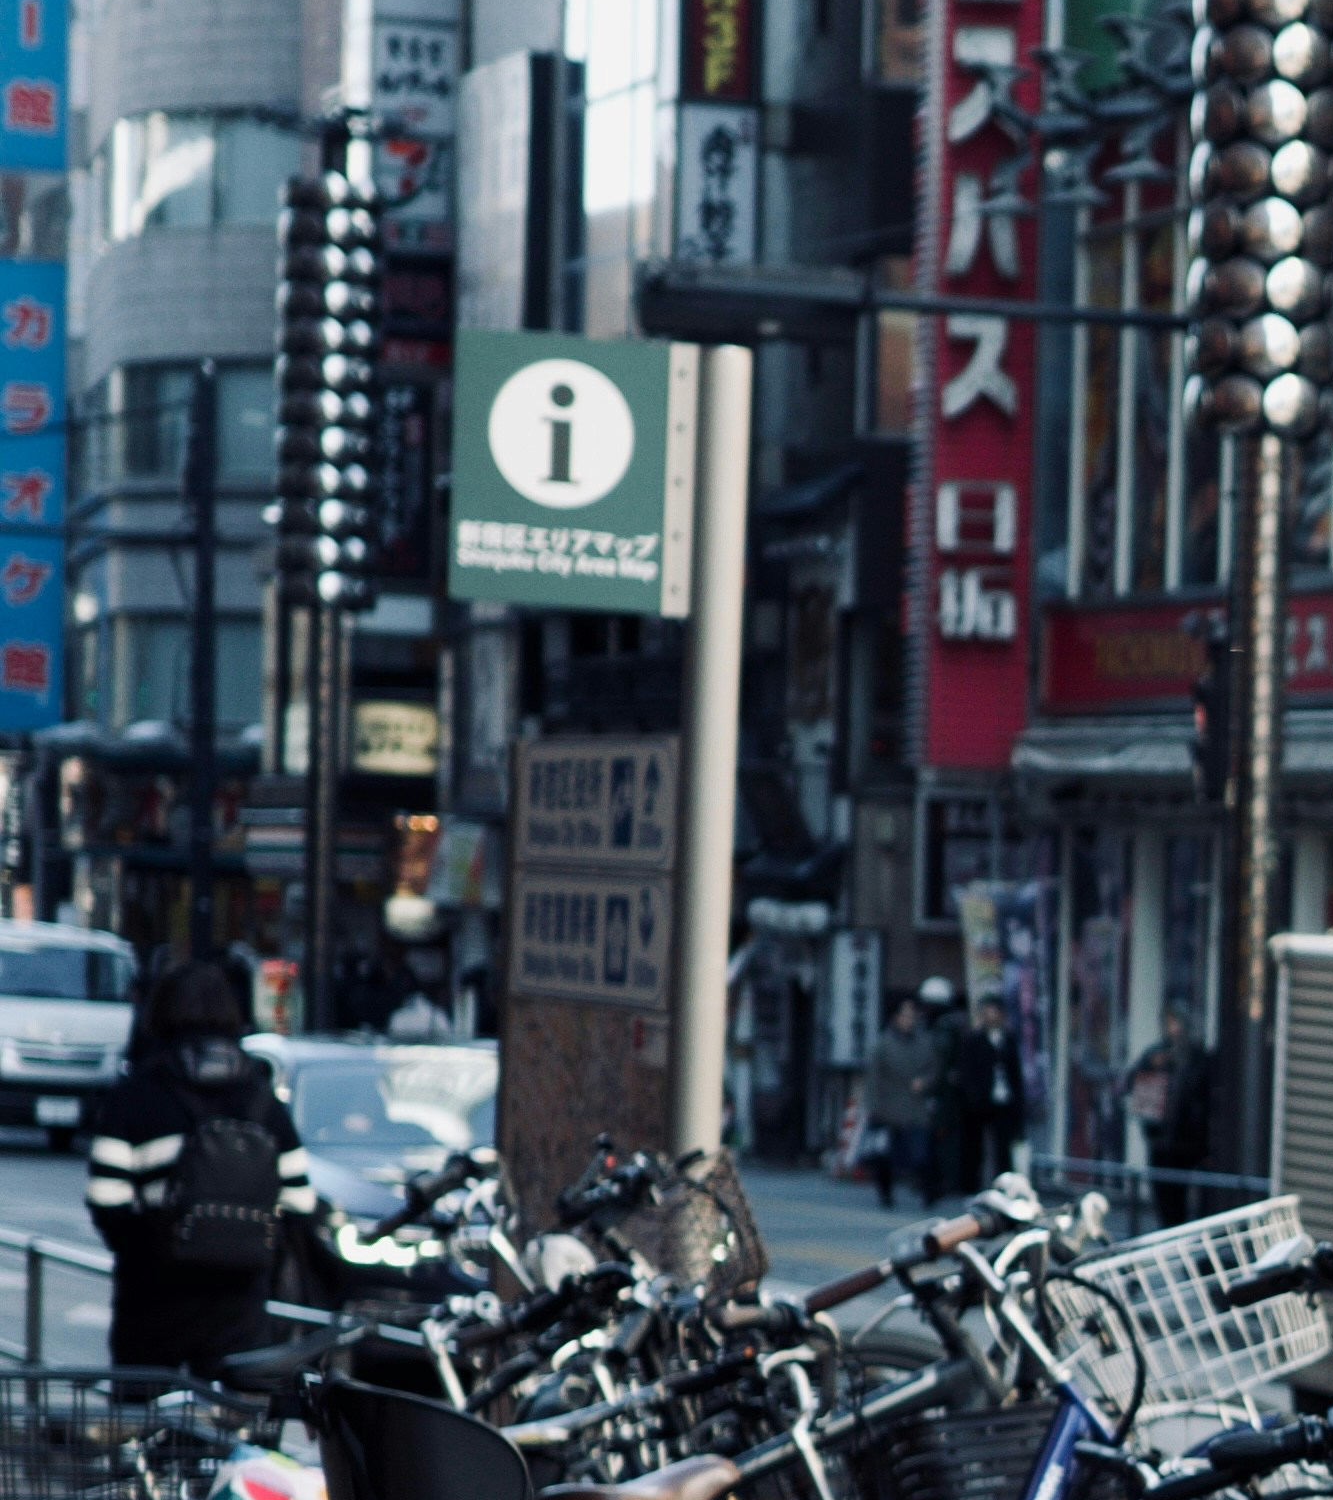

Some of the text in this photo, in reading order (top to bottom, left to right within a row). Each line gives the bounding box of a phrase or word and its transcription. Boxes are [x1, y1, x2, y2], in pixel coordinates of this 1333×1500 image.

[456, 519, 659, 559] 新宿区エリアマップ
